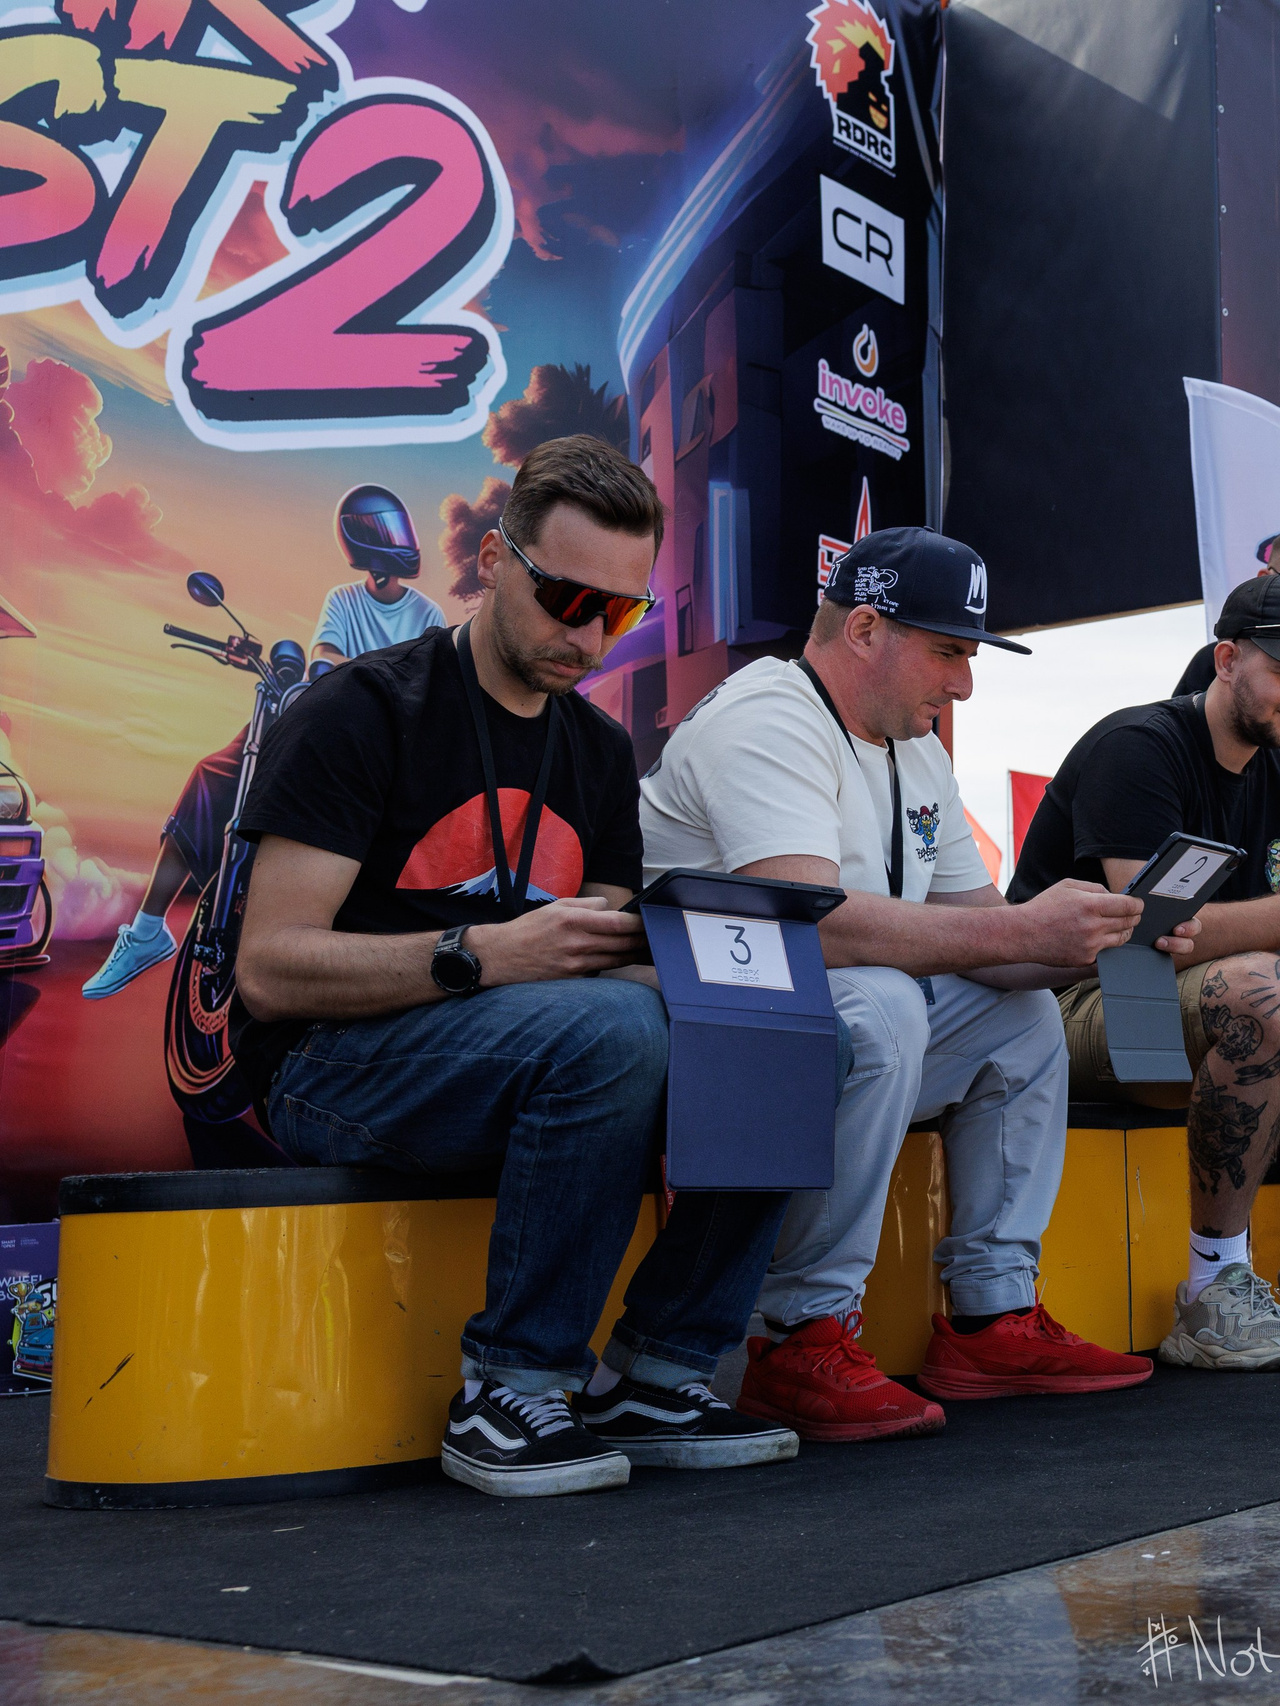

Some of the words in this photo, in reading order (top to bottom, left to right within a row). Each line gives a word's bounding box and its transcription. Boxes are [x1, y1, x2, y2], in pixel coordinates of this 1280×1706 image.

[836, 113, 893, 163] RDRC
[190, 101, 486, 392] 2
[832, 206, 894, 277] CR
[819, 359, 906, 432] invoke
[1179, 855, 1209, 884] 2
[724, 924, 752, 966] 3
